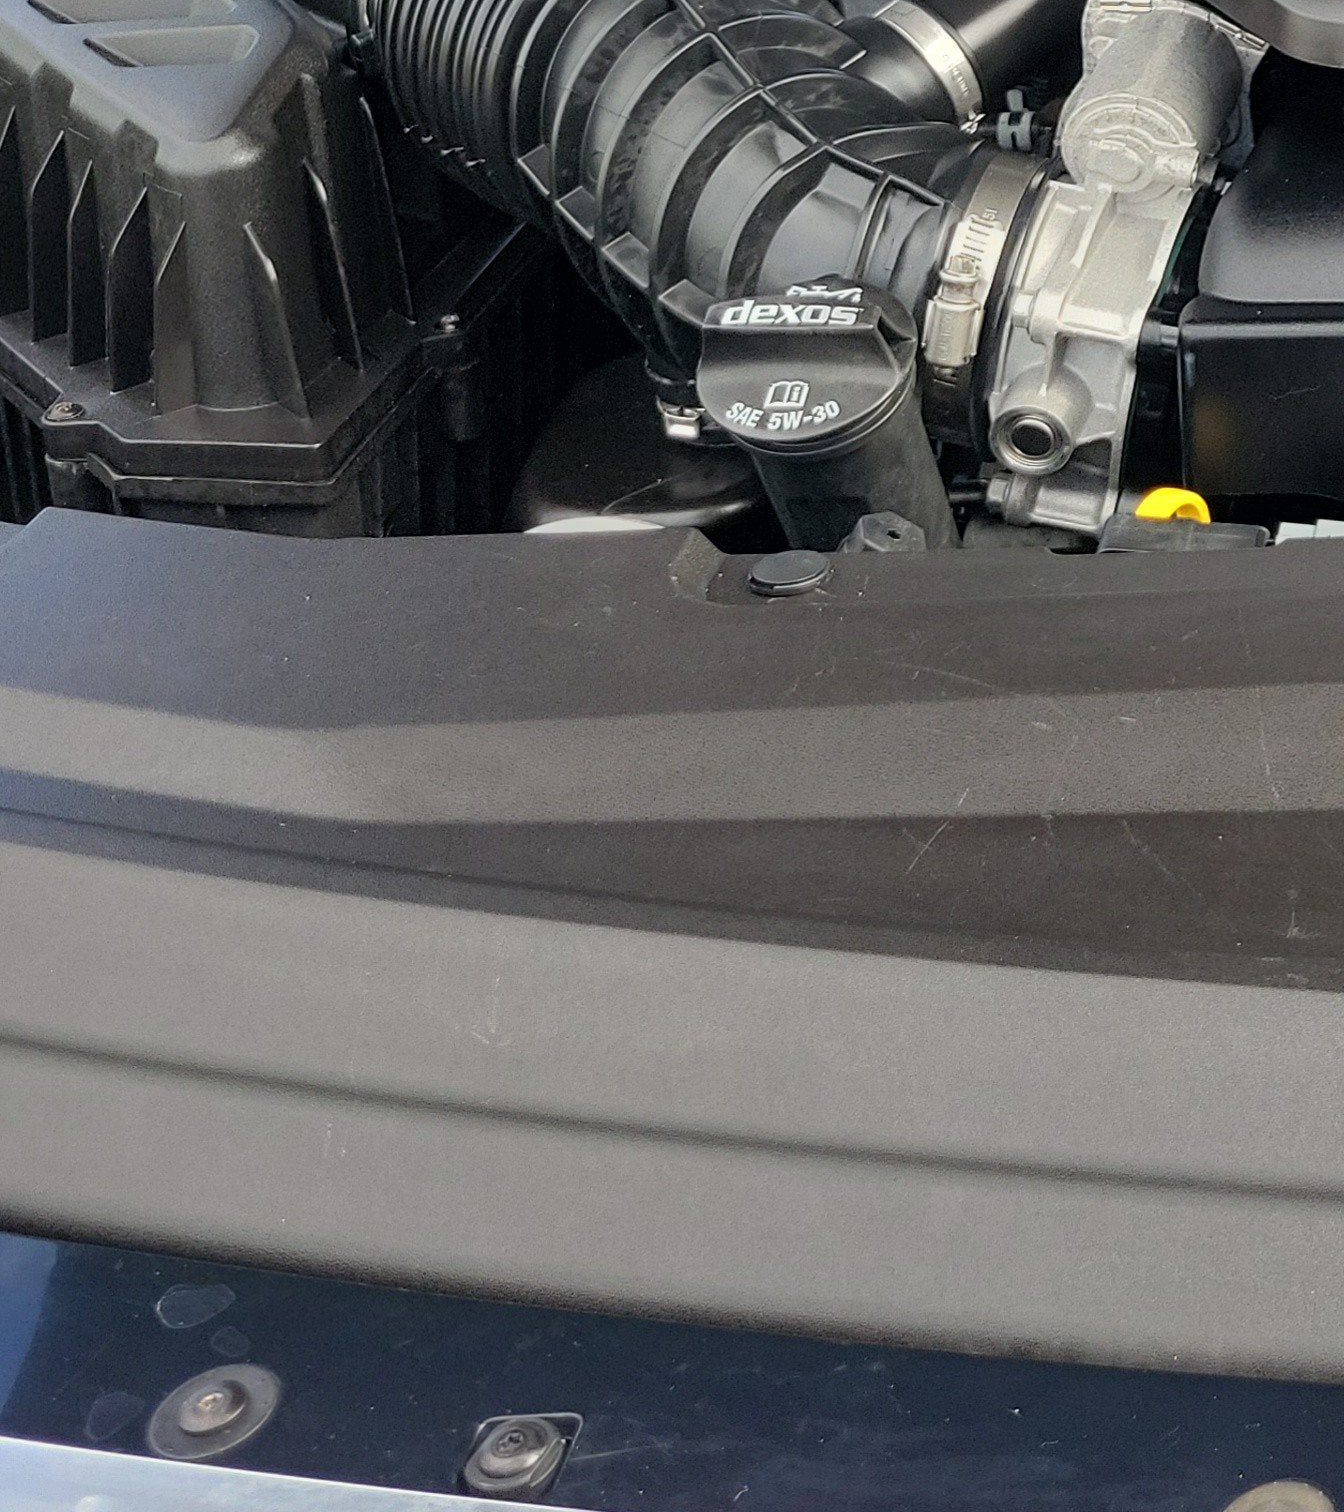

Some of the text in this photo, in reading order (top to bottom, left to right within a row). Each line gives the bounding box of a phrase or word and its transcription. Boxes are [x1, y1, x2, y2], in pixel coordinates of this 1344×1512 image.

[720, 299, 860, 326] dexos
[725, 400, 841, 430] SAE 5W-30
